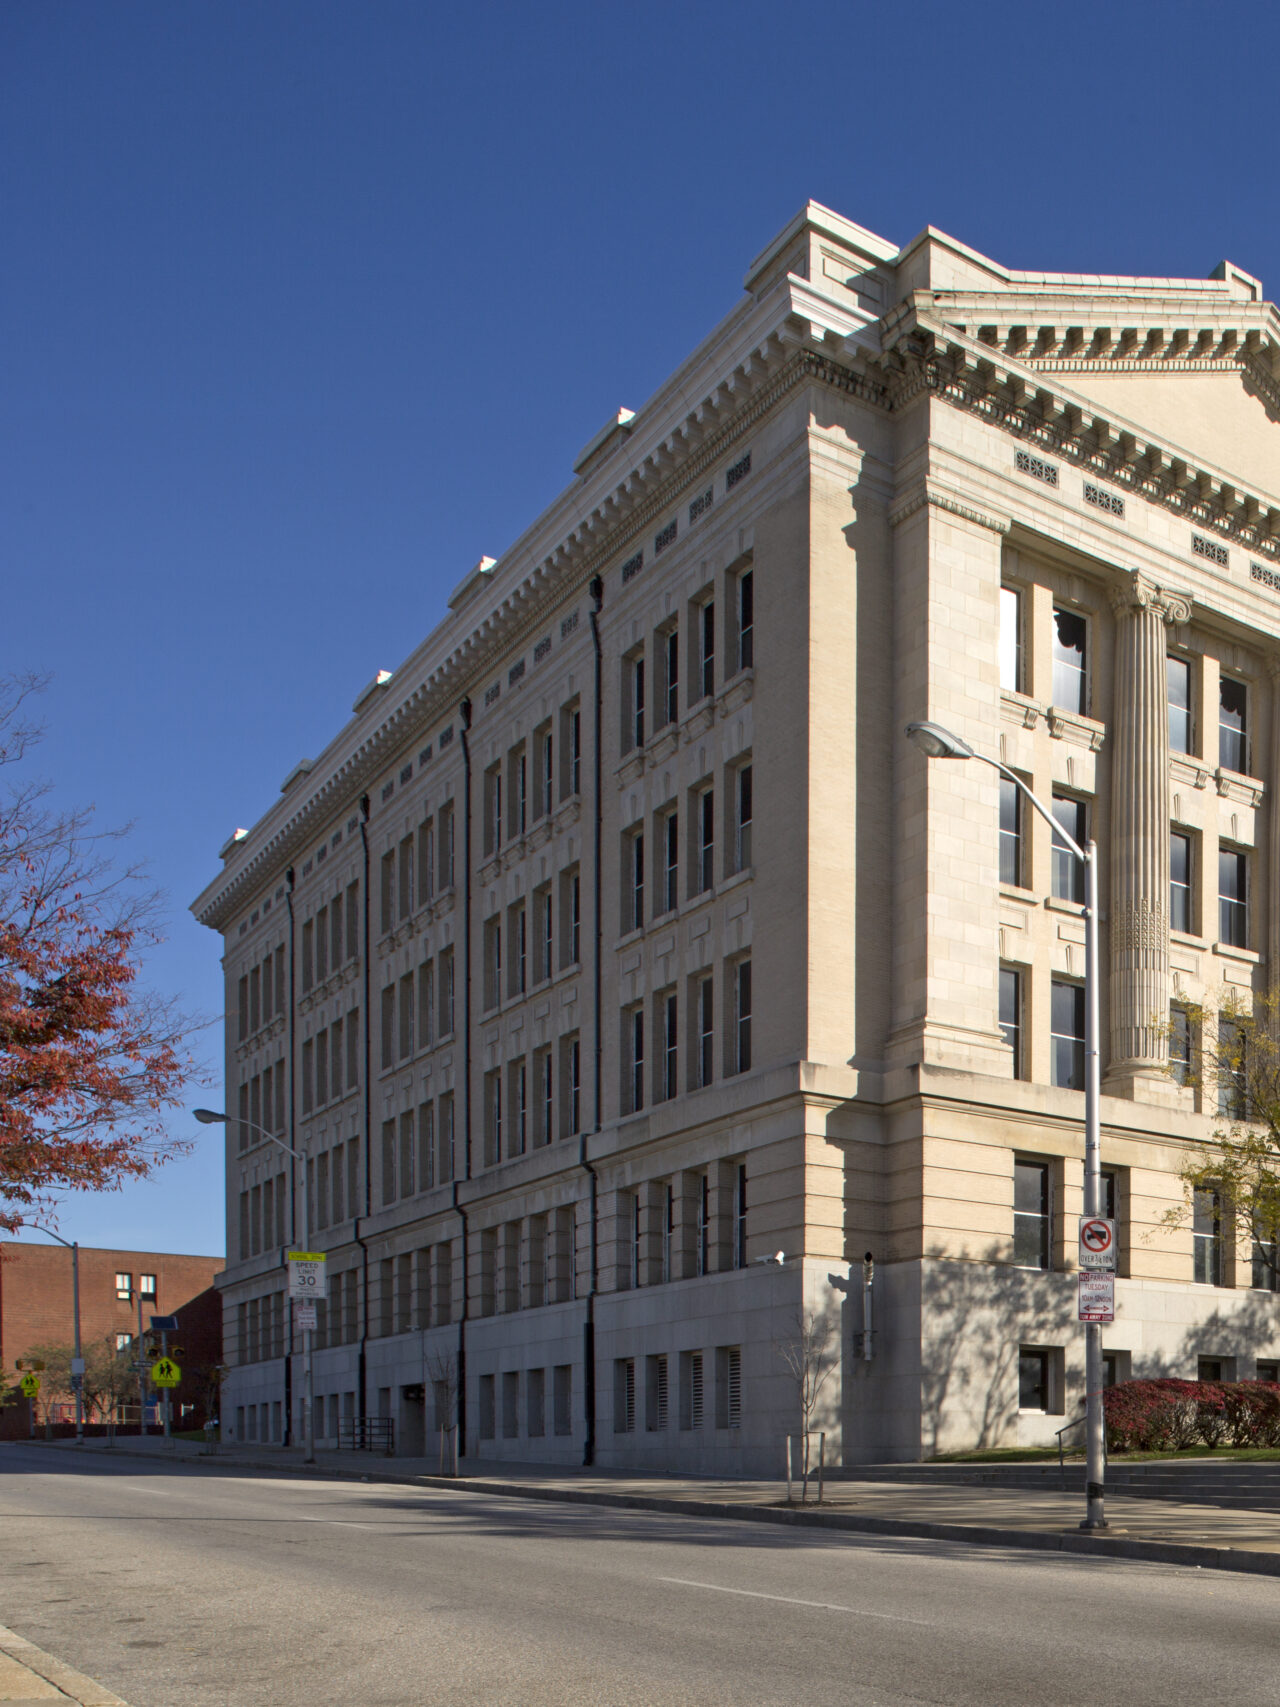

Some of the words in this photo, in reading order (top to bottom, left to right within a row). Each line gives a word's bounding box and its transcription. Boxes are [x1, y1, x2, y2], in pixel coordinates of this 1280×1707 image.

[1081, 1255, 1094, 1263] OVER
[298, 1275, 316, 1286] 30
[1080, 1273, 1089, 1281] NO
[1090, 1274, 1113, 1282] PARKING
[1085, 1283, 1108, 1291] TUESDAY
